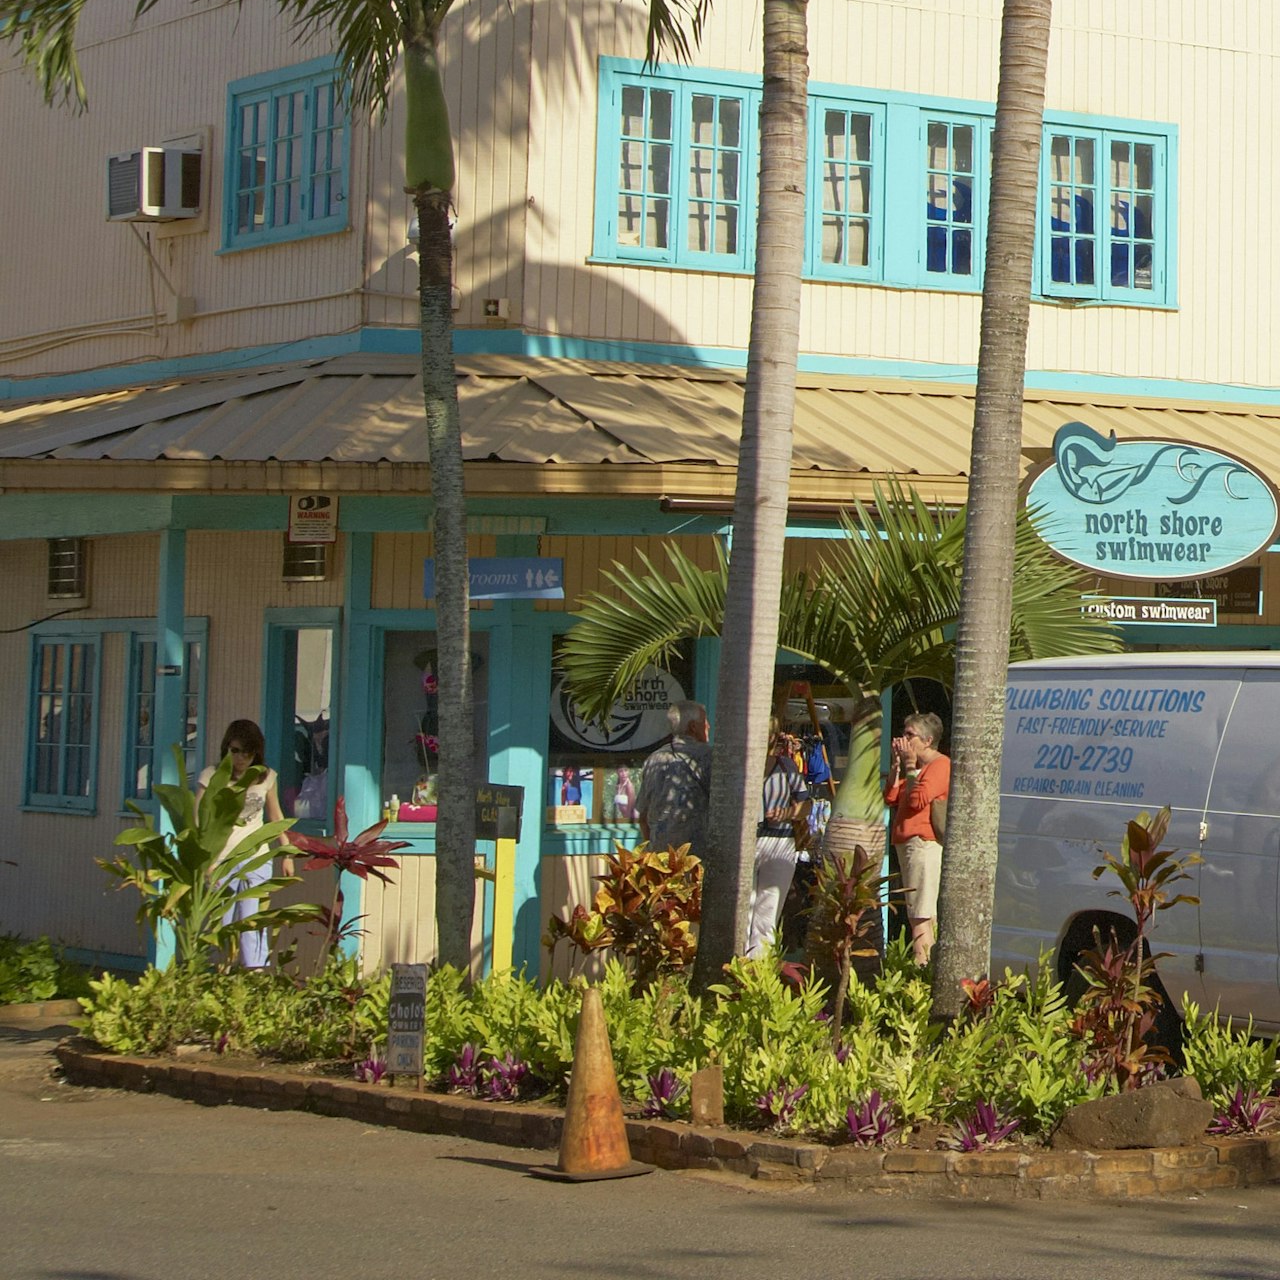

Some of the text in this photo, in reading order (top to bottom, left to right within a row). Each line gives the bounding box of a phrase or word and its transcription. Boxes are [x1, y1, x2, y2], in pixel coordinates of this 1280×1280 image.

[296, 511, 331, 520] WARNING
[1085, 509, 1223, 538] north shore
[1095, 537, 1212, 563] swimwear
[468, 570, 519, 586] rooms
[1141, 602, 1210, 621] swimwear
[1097, 688, 1206, 713] SOLUTIONS
[1034, 744, 1134, 773] 220-2739
[1094, 781, 1145, 799] CLEANING
